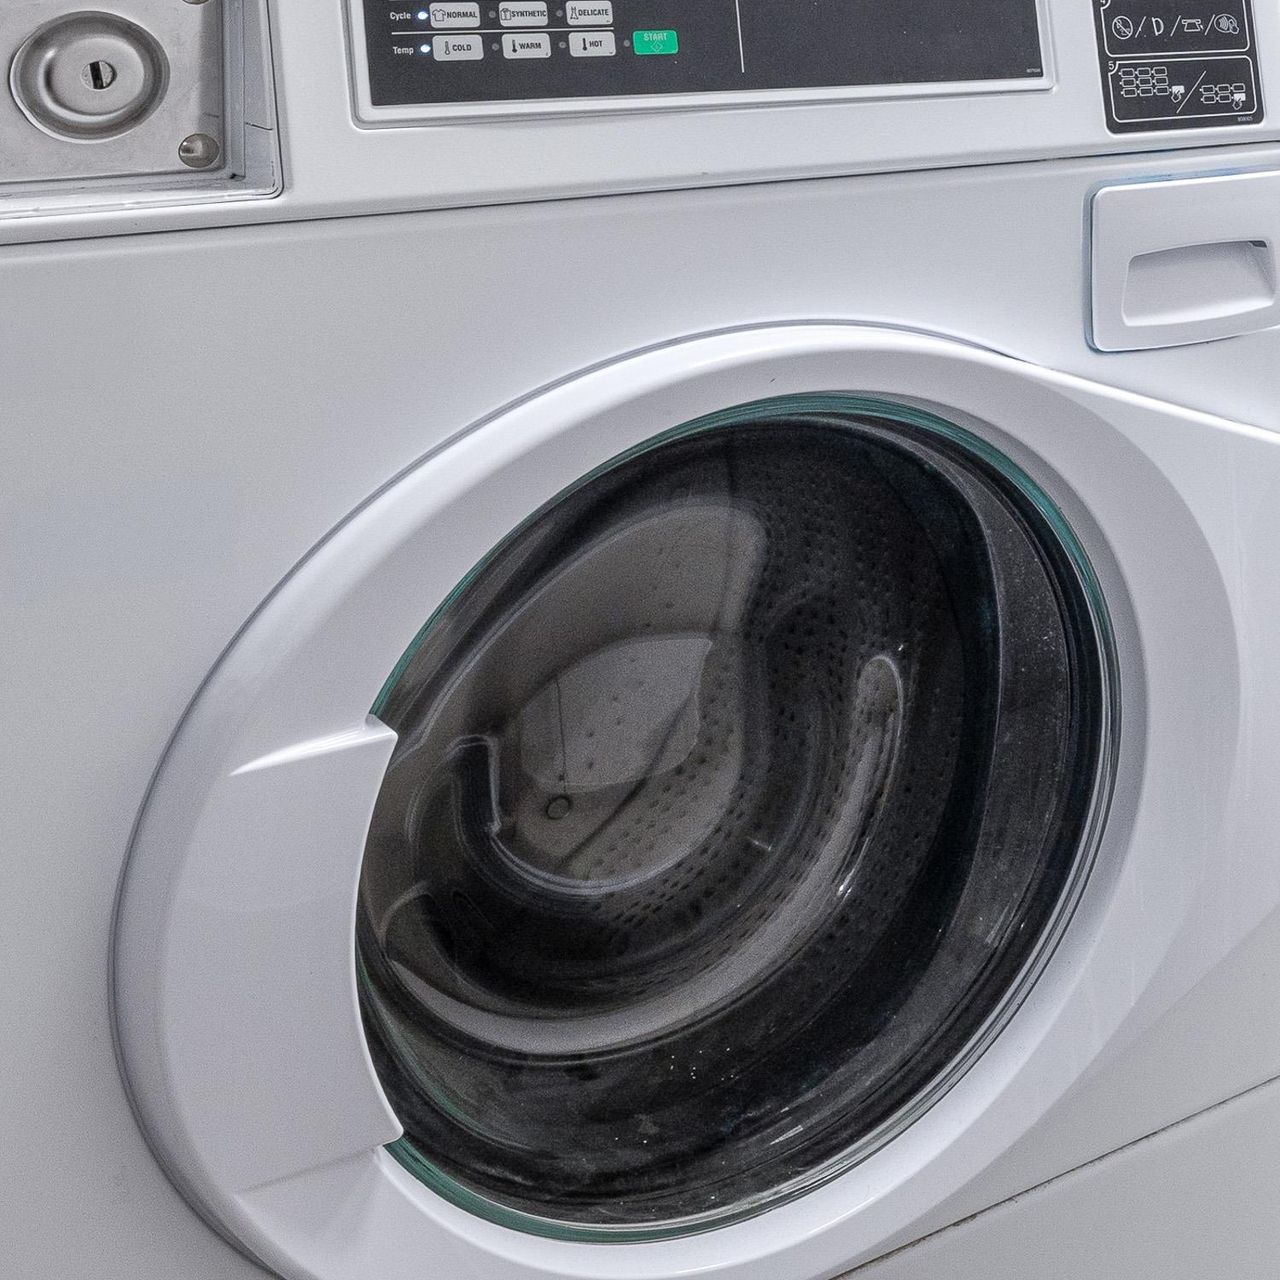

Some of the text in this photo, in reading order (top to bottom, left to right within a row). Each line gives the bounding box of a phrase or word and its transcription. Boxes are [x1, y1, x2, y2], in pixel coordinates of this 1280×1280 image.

[578, 8, 609, 16] DELICATE
[389, 12, 411, 21] Cycle
[643, 33, 668, 41] START
[519, 42, 542, 50] WARM
[392, 46, 414, 55] Temp
[1108, 61, 1115, 70] 5
